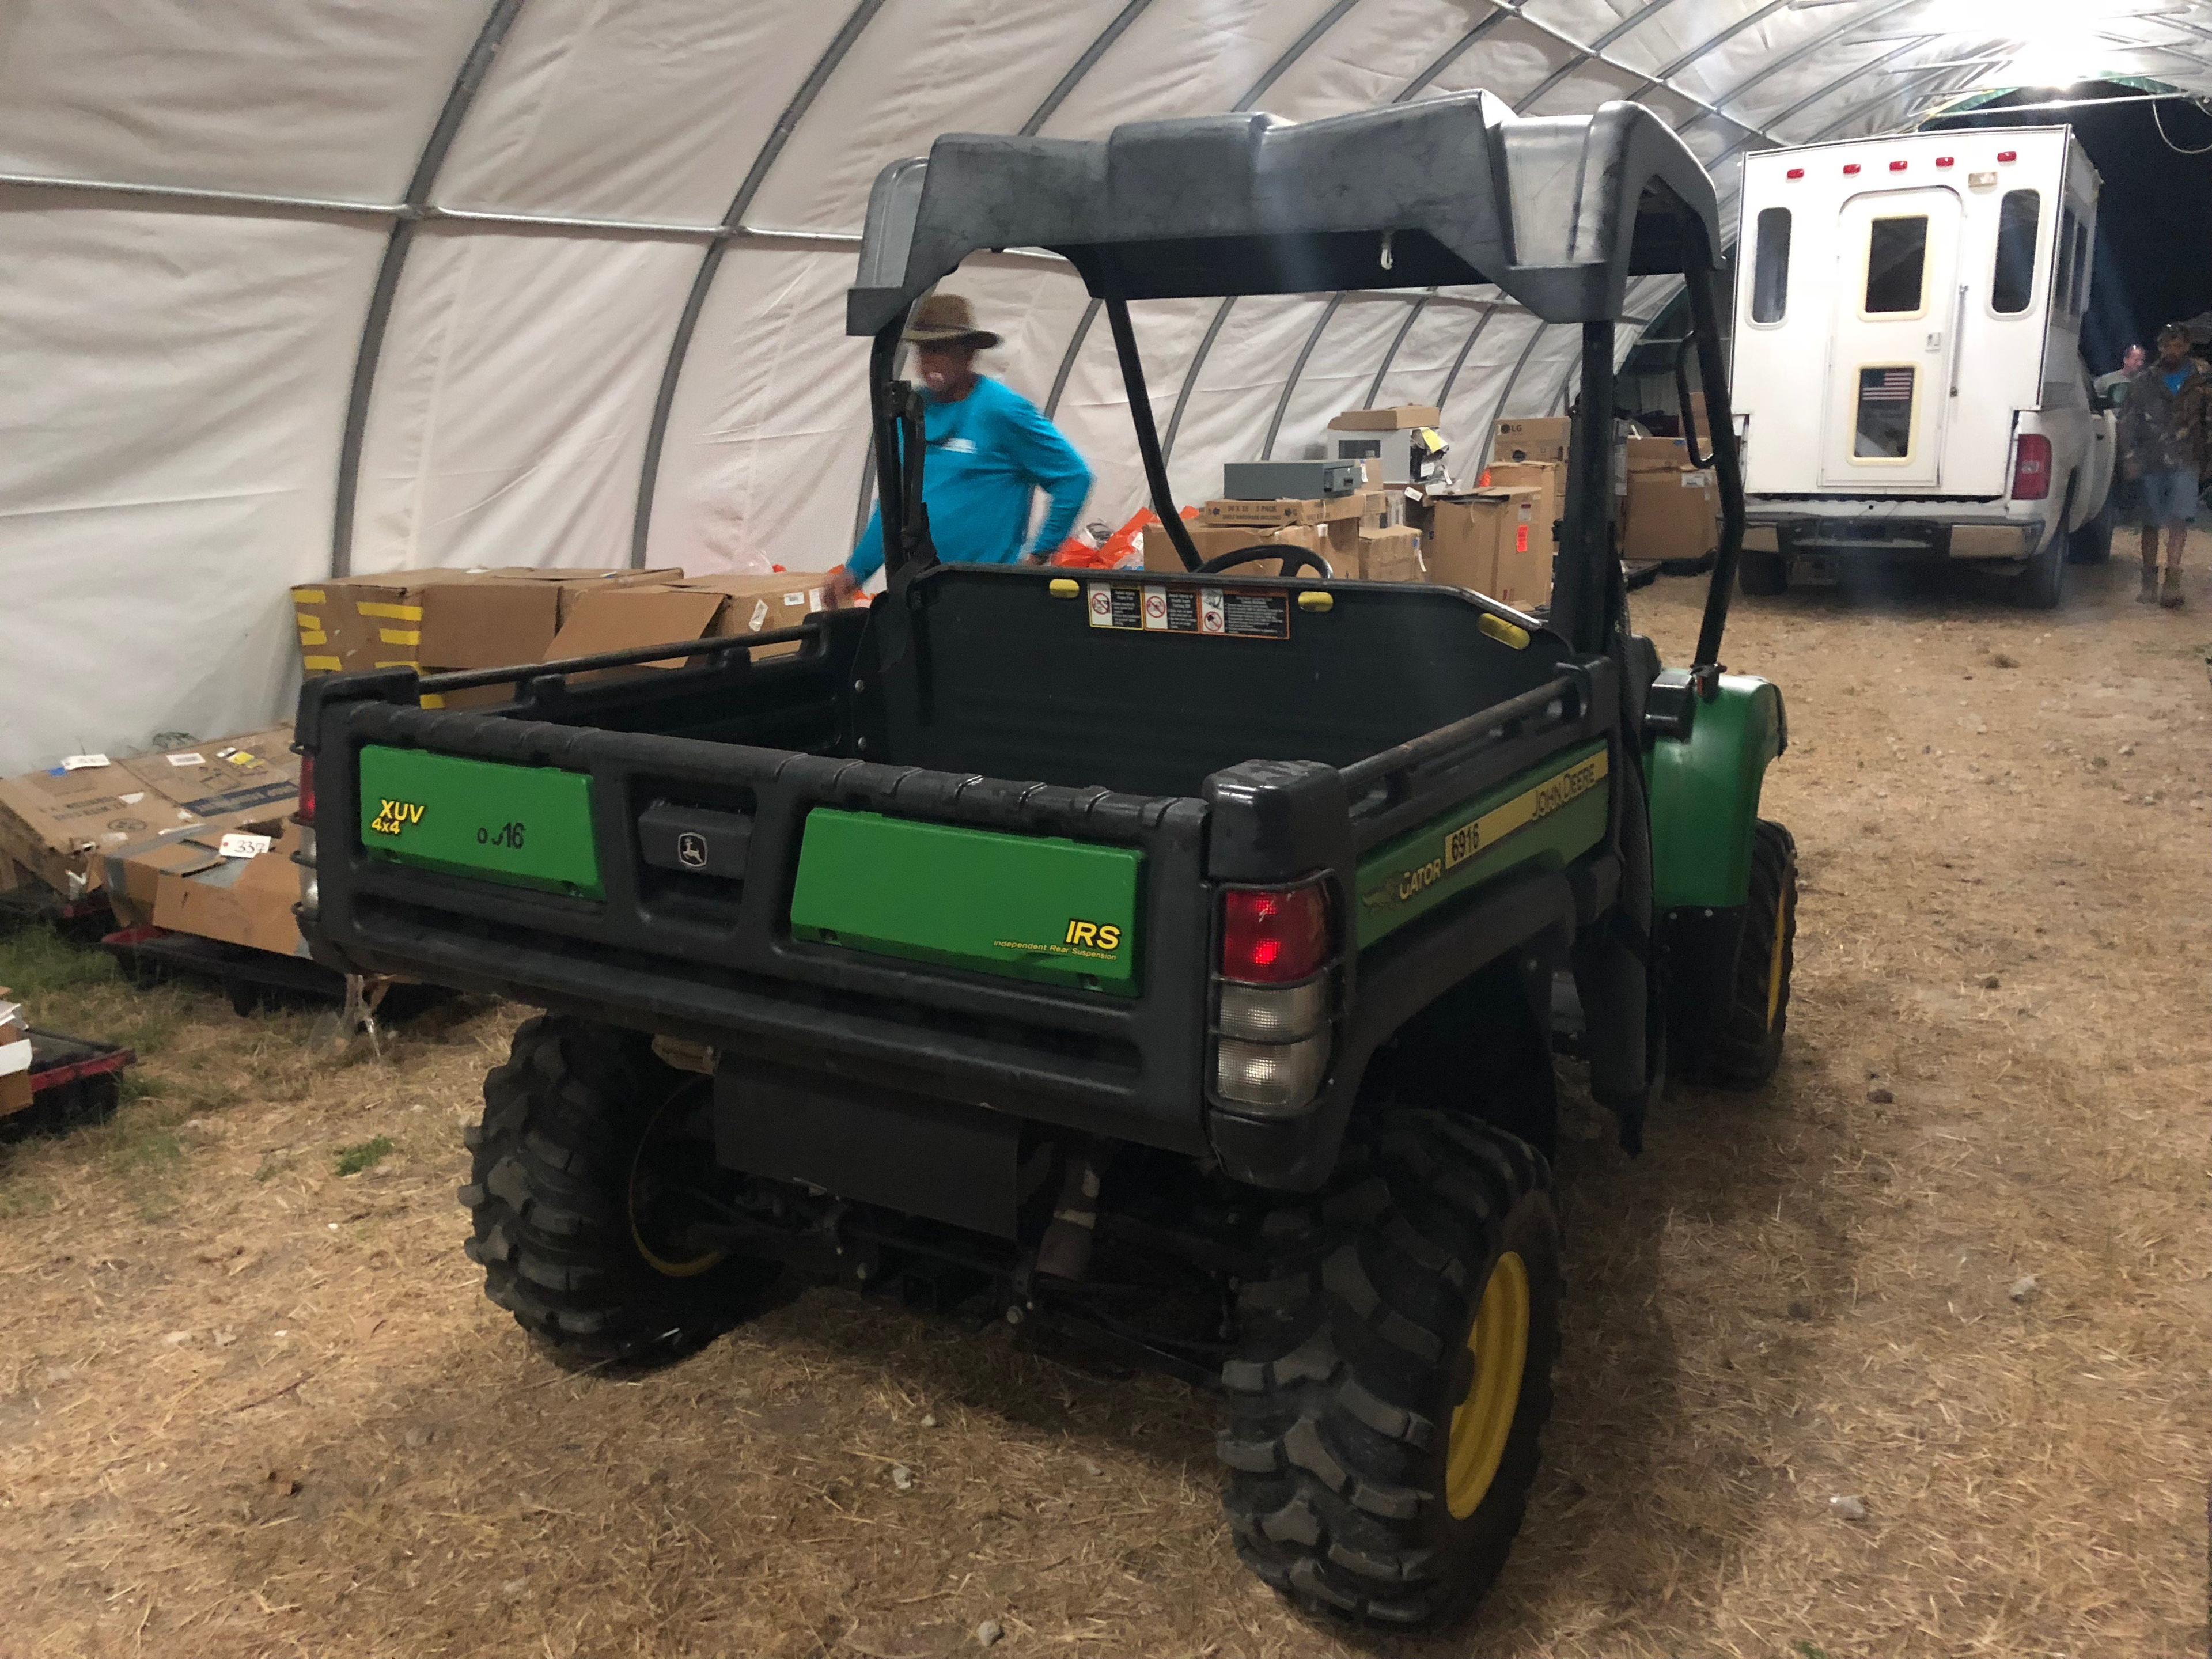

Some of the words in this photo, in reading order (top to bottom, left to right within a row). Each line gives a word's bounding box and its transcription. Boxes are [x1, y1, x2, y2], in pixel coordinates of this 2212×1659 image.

[379, 799, 425, 824] XUV
[371, 817, 401, 835] 4x4
[1399, 858, 1441, 900] GATOR
[1452, 822, 1480, 862] 6916
[1532, 782, 1562, 817] JOHN
[1562, 763, 1594, 803] DEERE
[1066, 921, 1120, 949] IRS
[993, 940, 1047, 951] Independent
[1050, 945, 1069, 953] Rear
[1071, 948, 1116, 961] Suspension
